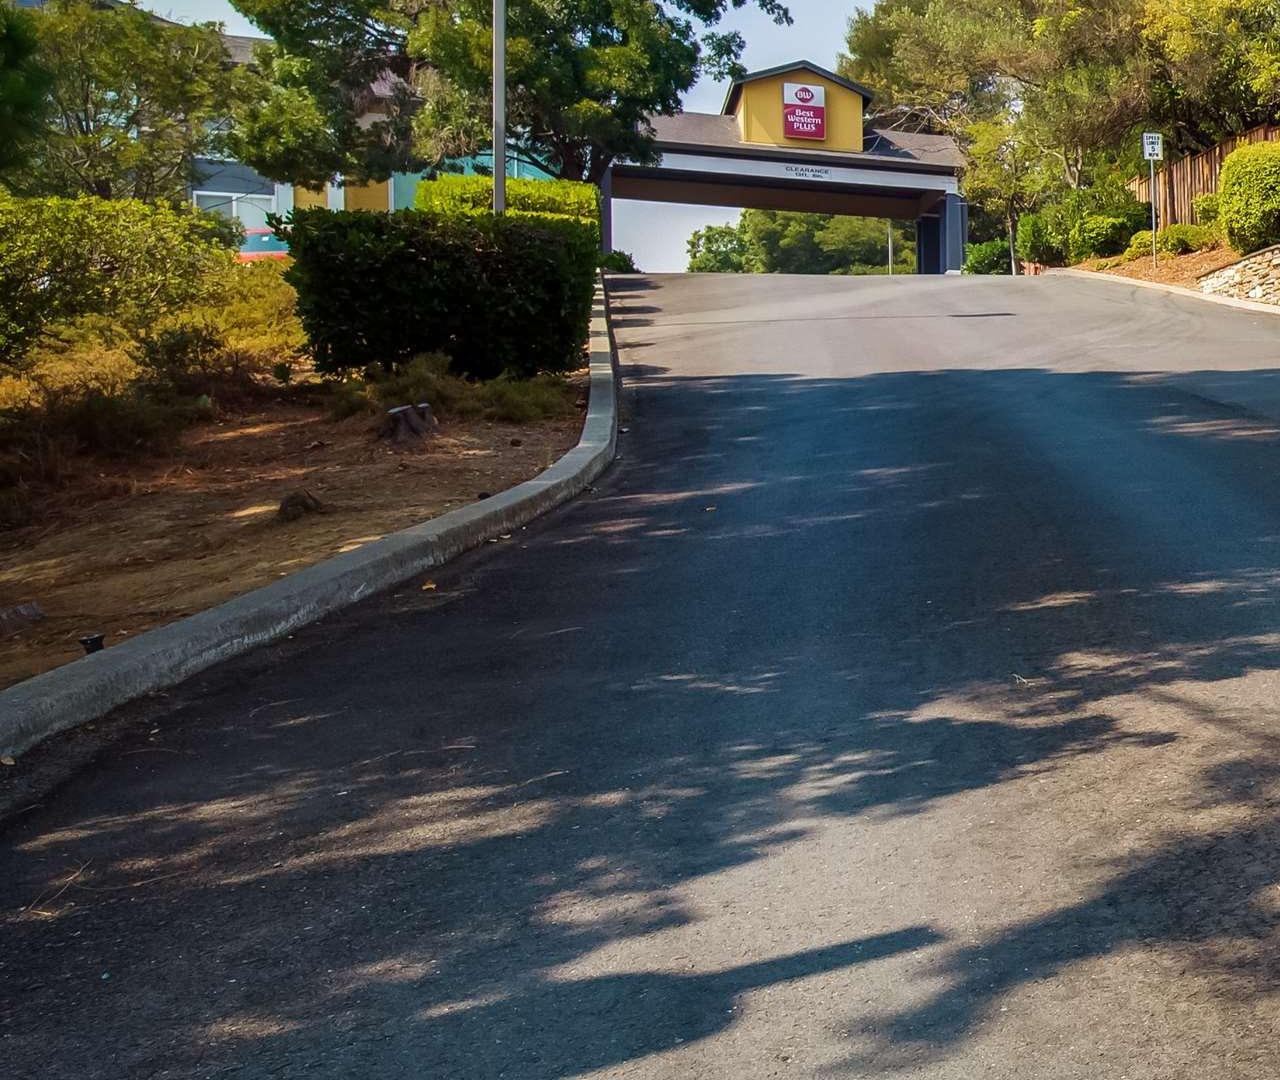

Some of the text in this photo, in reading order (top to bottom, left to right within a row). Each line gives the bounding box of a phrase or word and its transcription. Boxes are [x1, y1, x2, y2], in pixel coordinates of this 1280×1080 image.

[795, 109, 815, 117] Best
[787, 114, 822, 125] Western
[793, 122, 816, 130] PLUS
[785, 166, 829, 175] CLEARANCE
